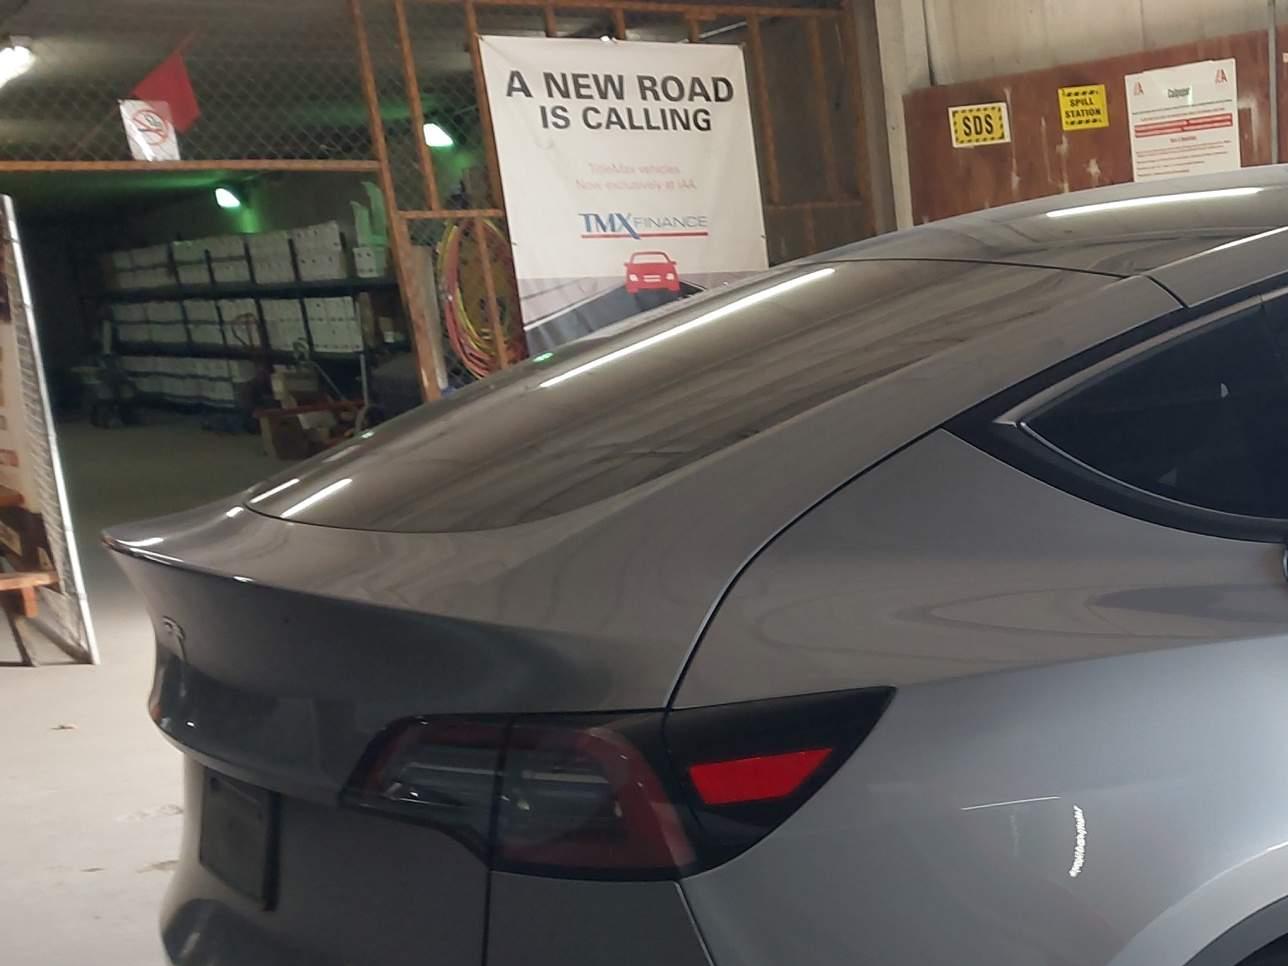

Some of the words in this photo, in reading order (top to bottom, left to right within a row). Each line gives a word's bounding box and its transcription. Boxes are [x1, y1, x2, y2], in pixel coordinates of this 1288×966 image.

[506, 70, 533, 98] A
[543, 72, 625, 101] NEW
[636, 75, 734, 103] ROAD
[1065, 109, 1101, 119] STATION
[1070, 98, 1095, 107] SPILL
[540, 105, 570, 129] IS
[582, 106, 712, 132] CALLING
[962, 113, 994, 137] SDS
